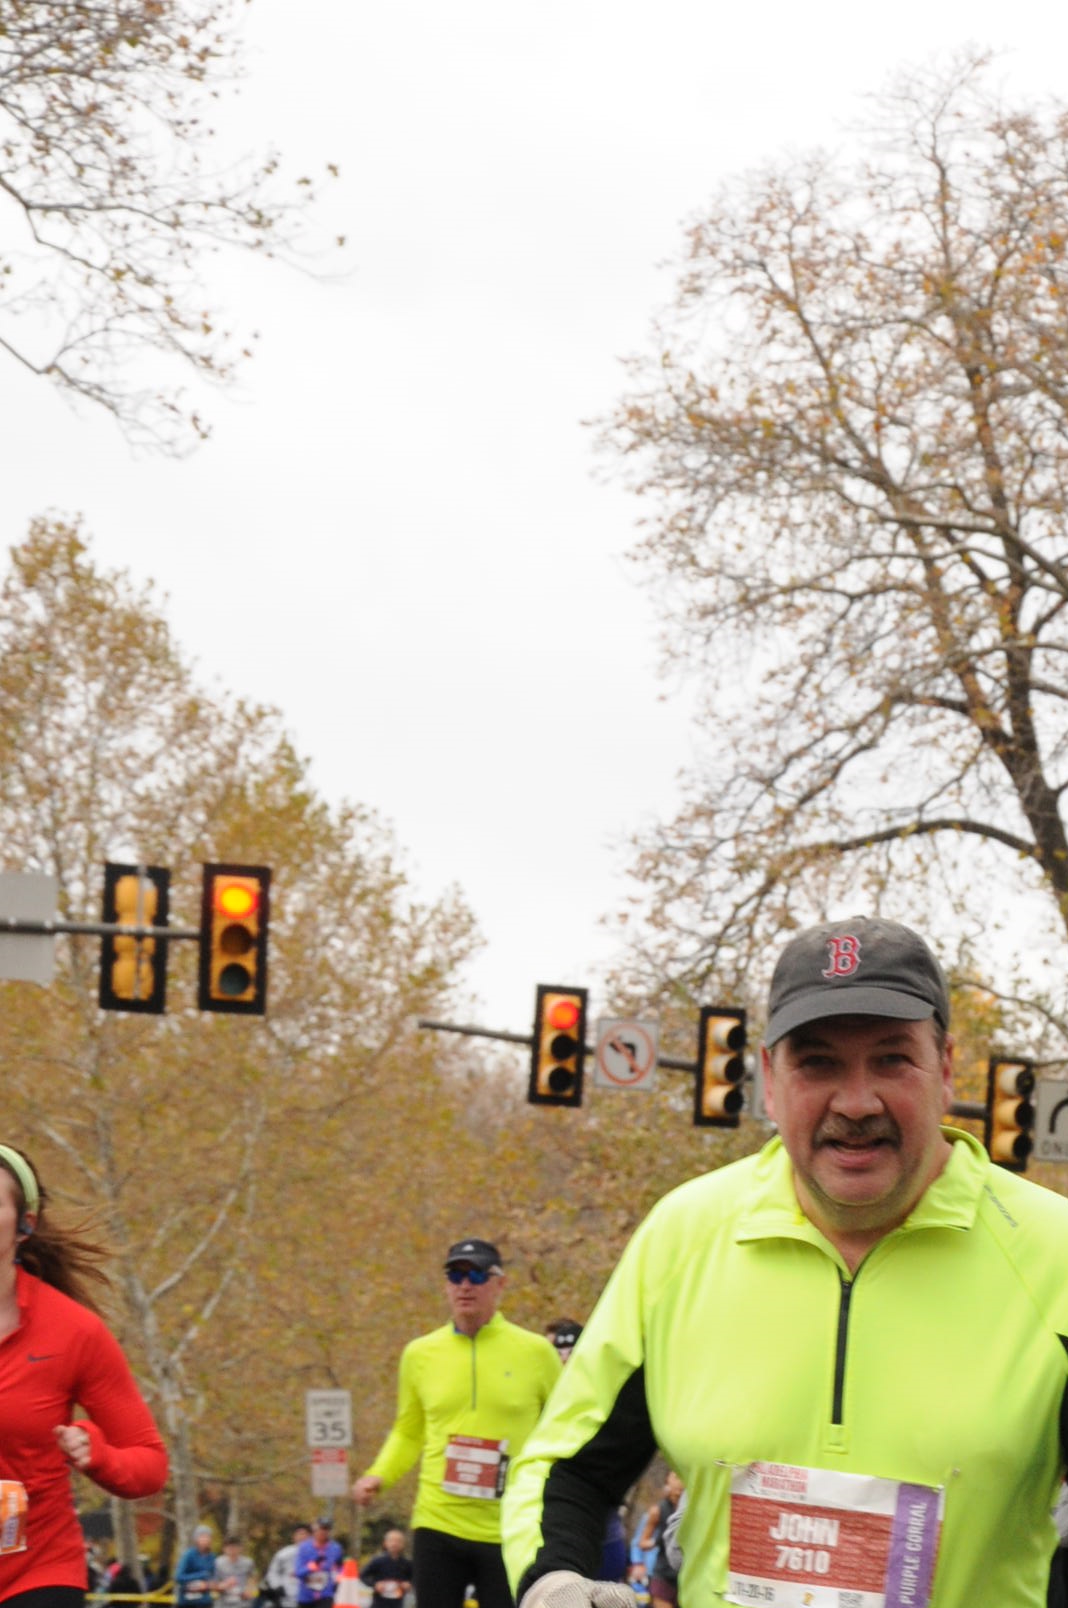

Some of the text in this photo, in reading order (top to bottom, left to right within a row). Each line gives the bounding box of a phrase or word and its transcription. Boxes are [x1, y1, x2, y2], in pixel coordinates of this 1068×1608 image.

[821, 934, 862, 979] B
[313, 1421, 346, 1442] 35
[768, 1512, 840, 1548] JOHN
[775, 1547, 831, 1574] 7610
[899, 1501, 928, 1605] PURPLE CORRAL
